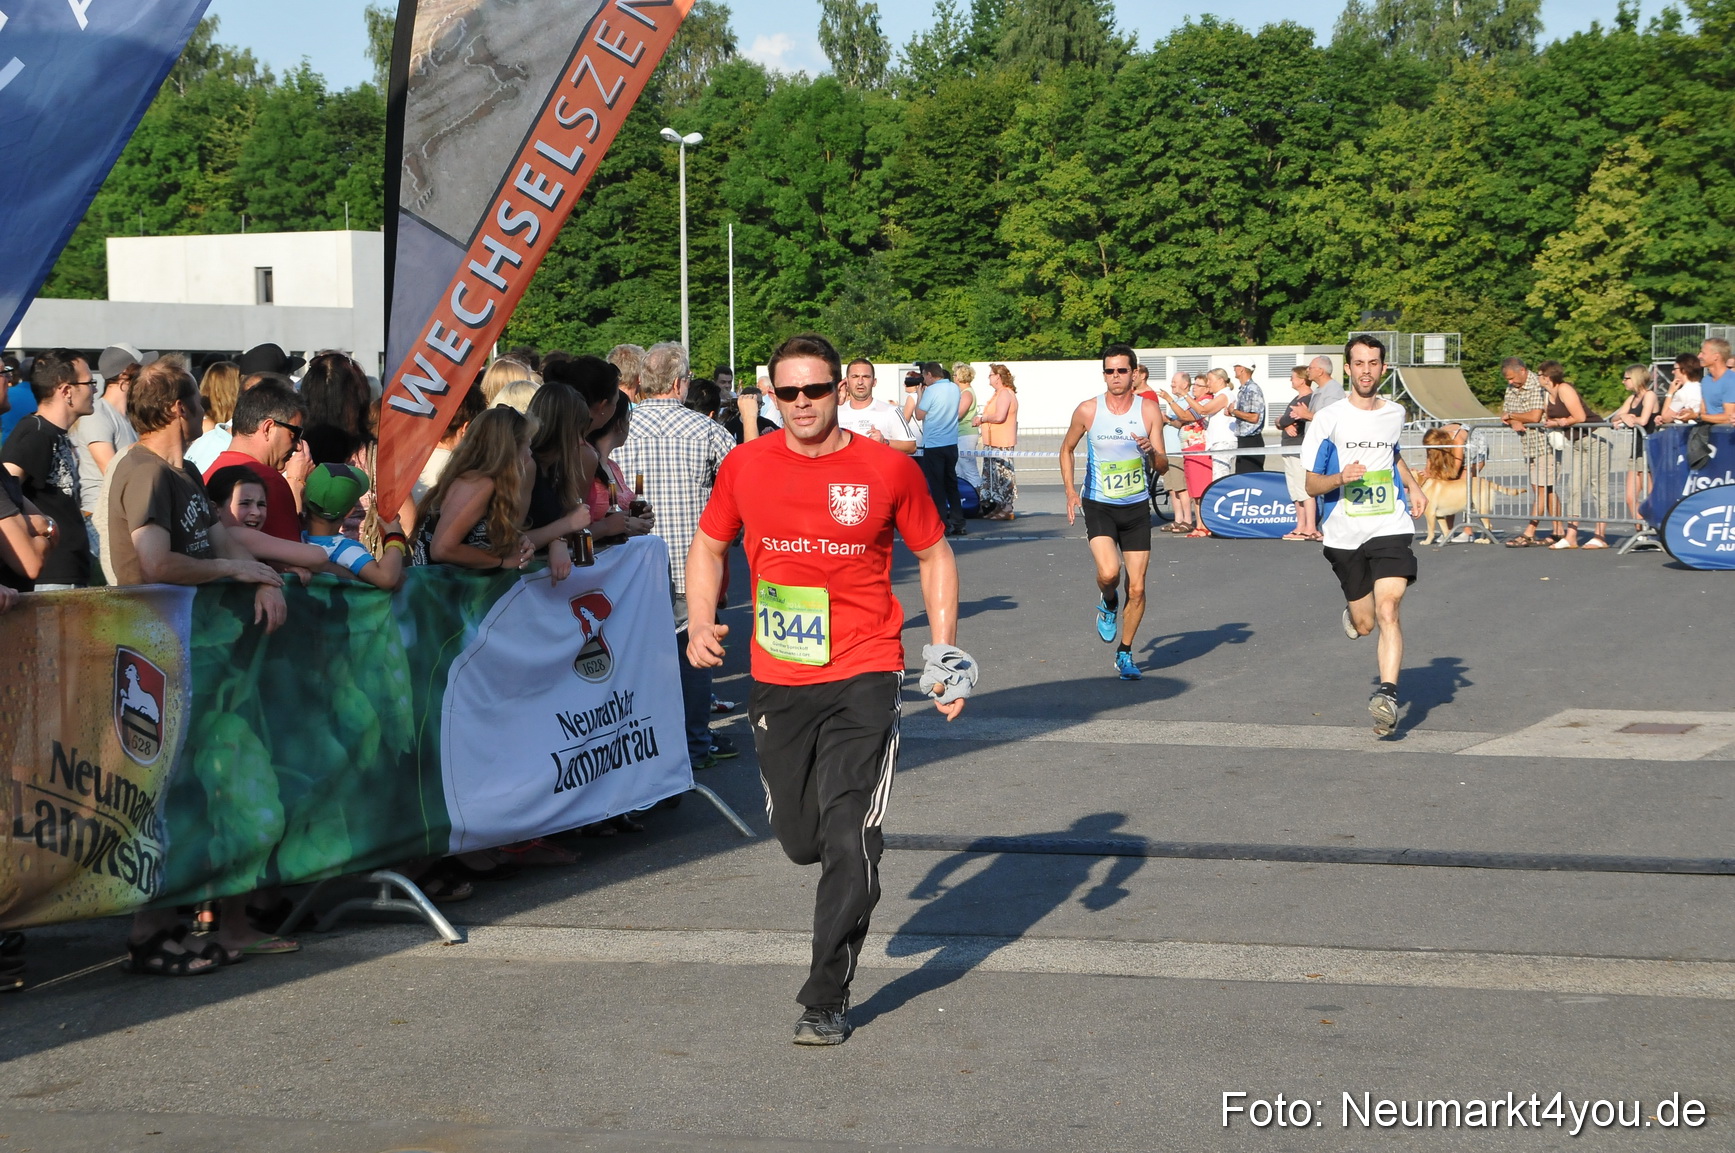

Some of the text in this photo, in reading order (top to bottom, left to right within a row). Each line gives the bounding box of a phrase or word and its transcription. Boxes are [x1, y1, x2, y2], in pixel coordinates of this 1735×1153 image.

[1345, 441, 1394, 449] DELPH
[1103, 469, 1142, 490] 1215
[1351, 485, 1387, 505] 219
[1230, 500, 1297, 517] Fische
[1237, 516, 1298, 524] AUTOMOBIL
[761, 536, 866, 556] Stadt-Team
[758, 607, 826, 646] 1344
[582, 658, 606, 676] 1628
[126, 734, 152, 757] 628
[551, 719, 660, 795] Lammsbräu
